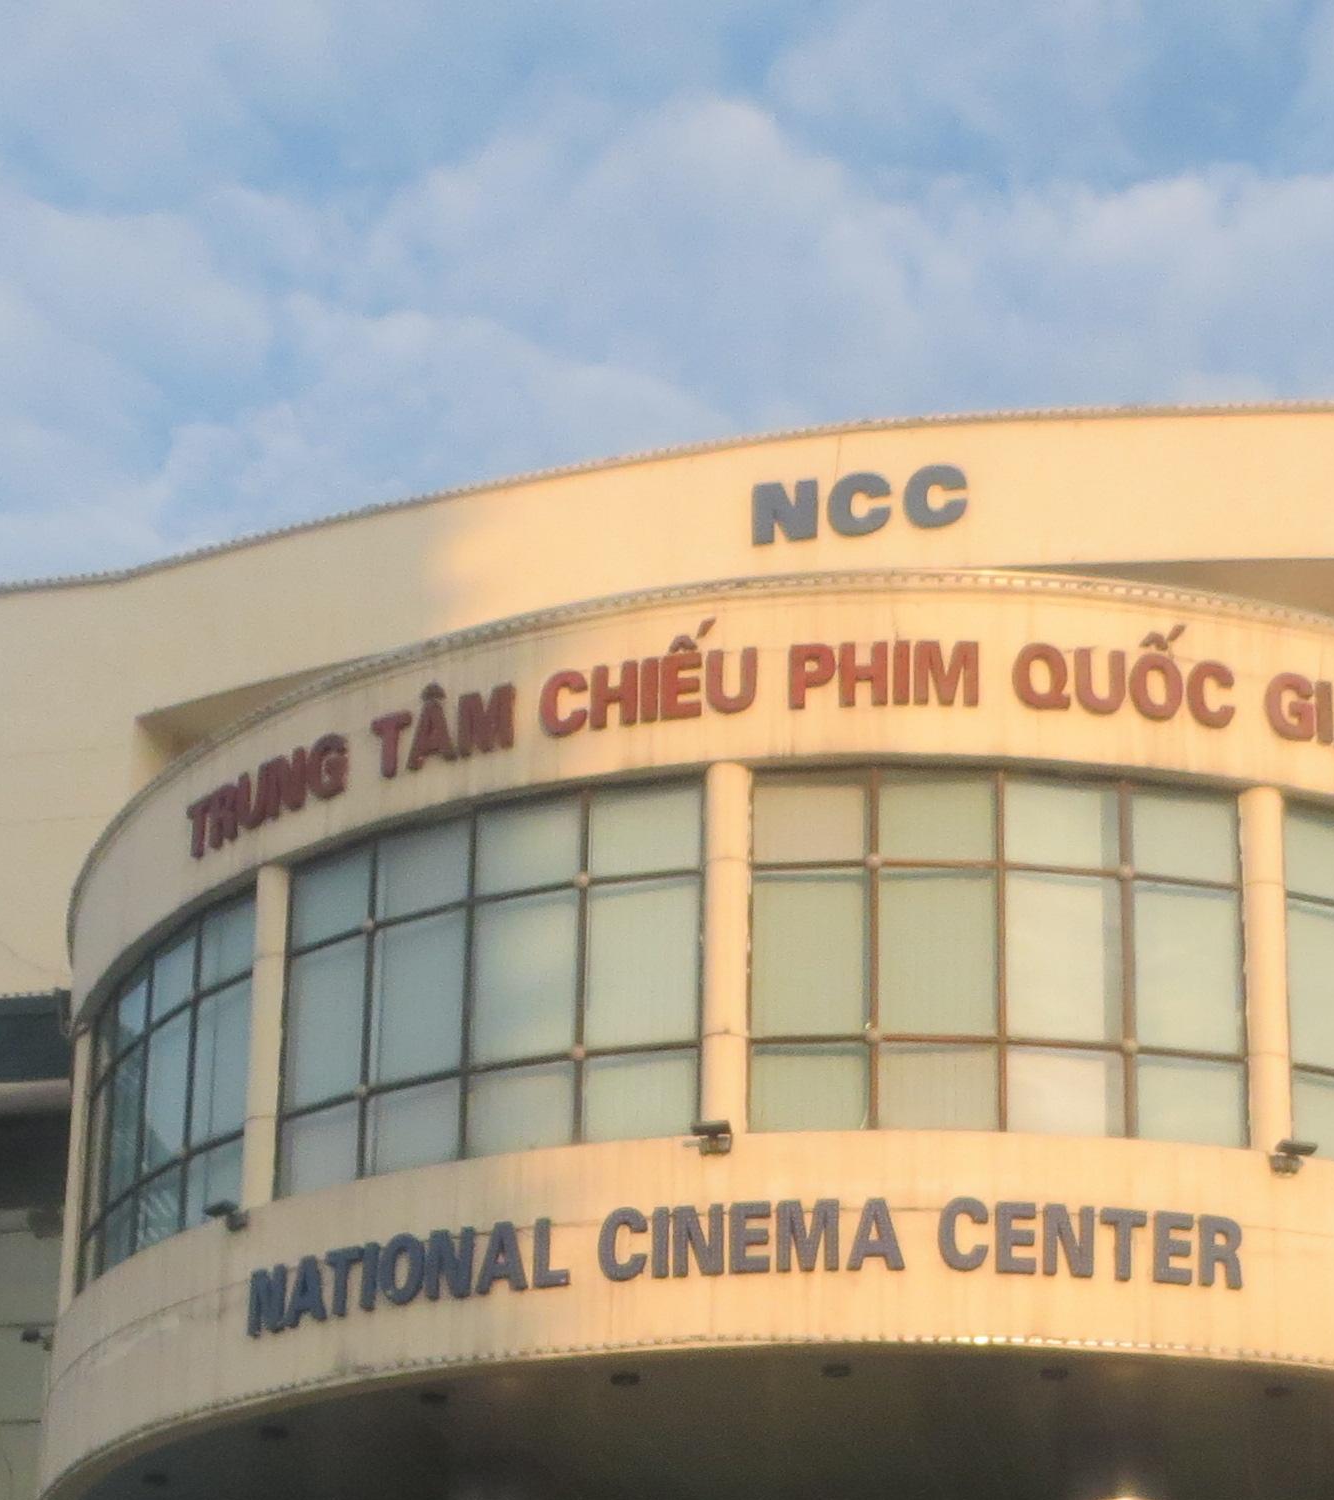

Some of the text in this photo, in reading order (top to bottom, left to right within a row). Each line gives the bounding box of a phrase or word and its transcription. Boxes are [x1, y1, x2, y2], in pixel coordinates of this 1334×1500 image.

[751, 464, 968, 546] NCC
[186, 732, 350, 860] TRUNG
[371, 681, 517, 779] TÂM
[539, 617, 758, 738] CHIẾU
[787, 640, 980, 711] PHIM
[1012, 624, 1236, 730] QUỐC
[246, 1196, 1243, 1340] NATIONAL CINEMA CENTER
